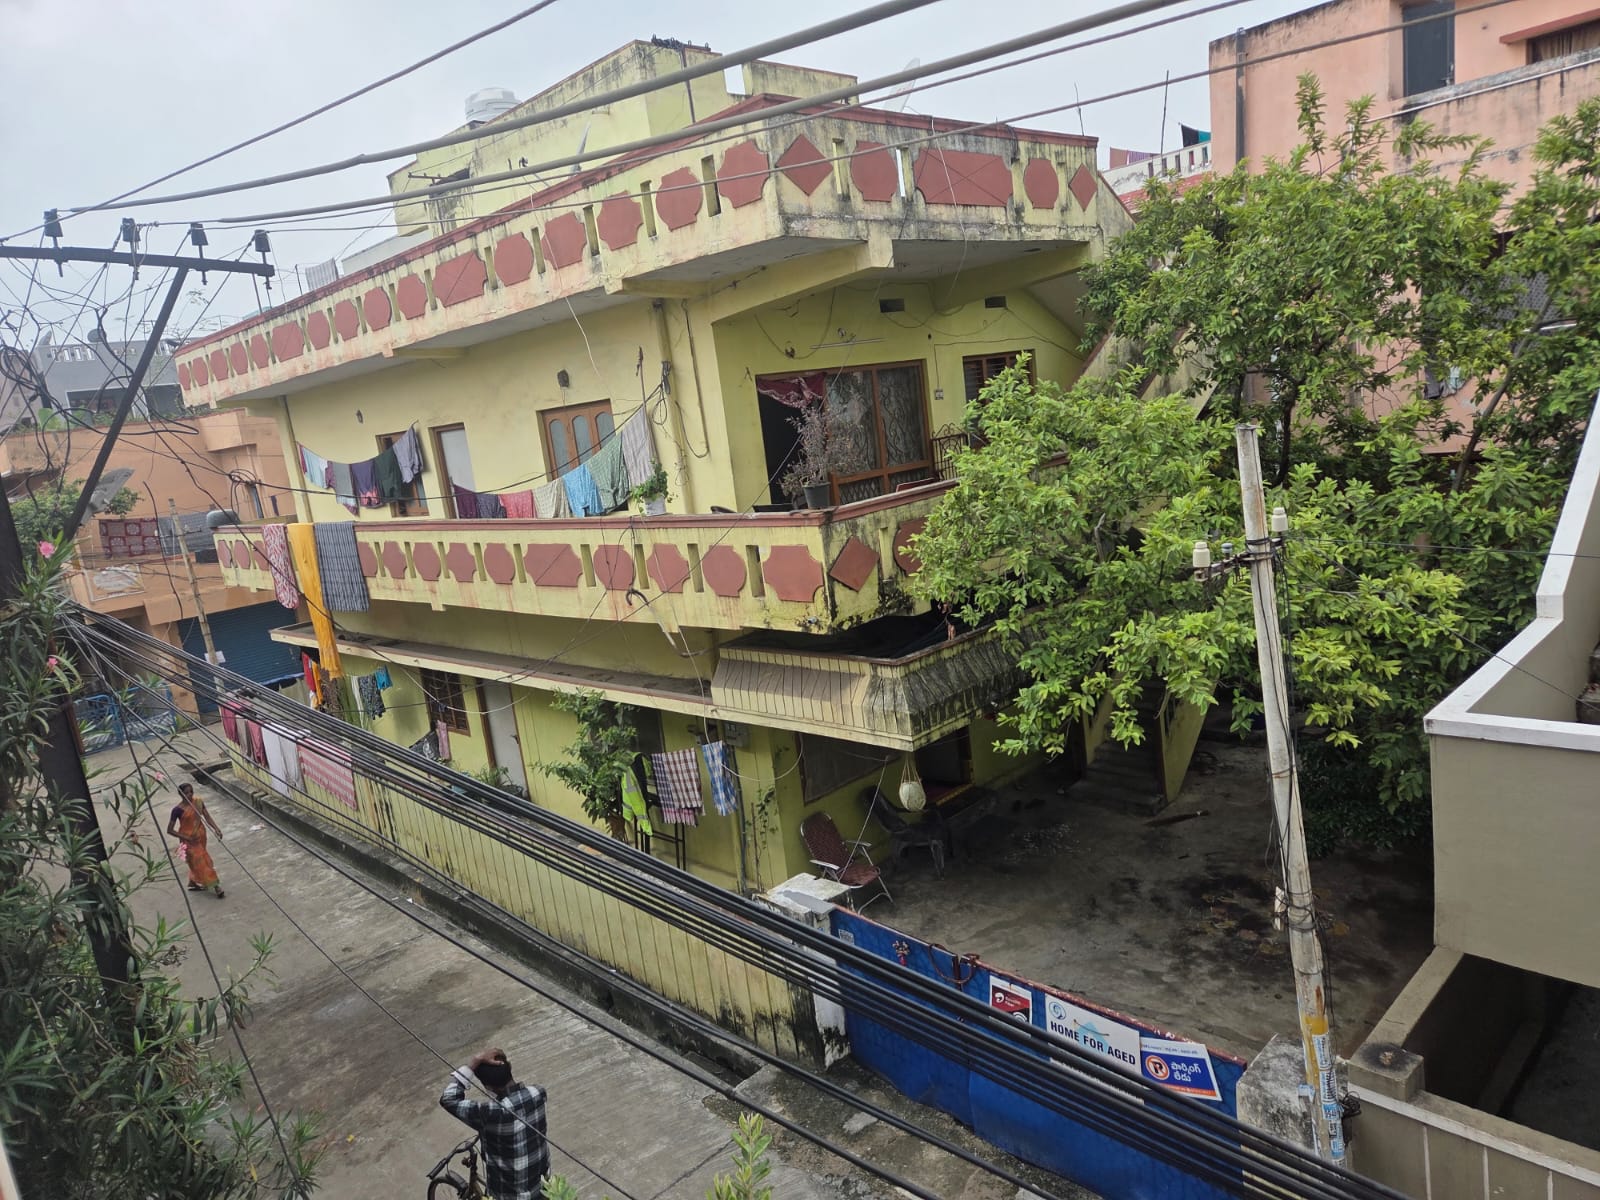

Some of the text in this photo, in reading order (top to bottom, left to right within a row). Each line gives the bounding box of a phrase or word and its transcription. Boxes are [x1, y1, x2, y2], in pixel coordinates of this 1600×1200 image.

[1050, 1020, 1080, 1042] HOME
[1083, 1035, 1104, 1052] FOR
[1107, 1045, 1136, 1065] AGED
